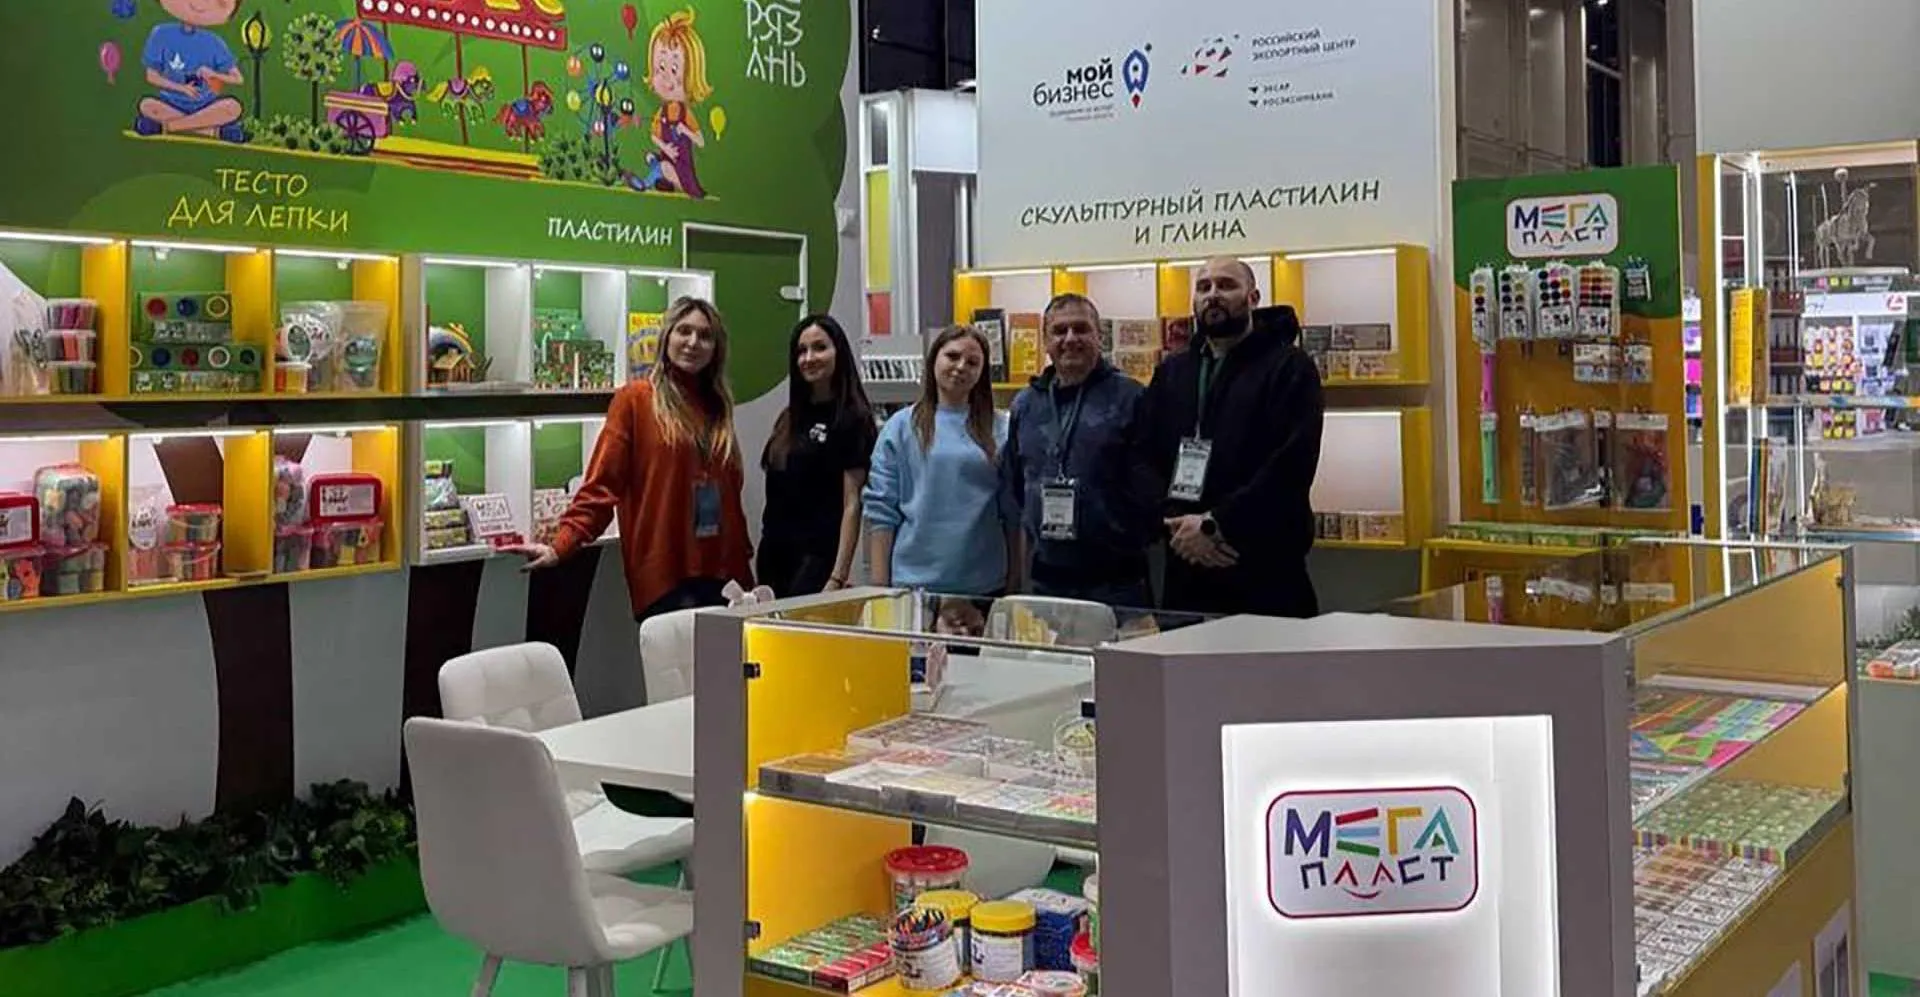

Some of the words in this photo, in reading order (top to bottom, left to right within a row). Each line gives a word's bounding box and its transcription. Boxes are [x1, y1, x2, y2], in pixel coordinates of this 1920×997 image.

[1252, 28, 1320, 47] РОССИЙСКИЙ
[1252, 43, 1320, 61] ЭКСПОРТНЫЙ
[1322, 39, 1357, 51] ЦЕНТР
[1033, 81, 1114, 106] бизнес
[215, 169, 308, 197] ТЕСТО
[167, 196, 235, 228] ДЛЯ
[245, 204, 350, 232] ЛЕПКИ
[1020, 188, 1204, 227] СКУЛЬПТУРНЫЙ
[1213, 180, 1381, 212] ПЛАСТИЛИН
[1514, 203, 1608, 230] МЕГА
[547, 217, 673, 246] ПЛАСТИЛИН
[1134, 225, 1150, 244] И
[1161, 219, 1247, 243] ГЛИНА
[1284, 806, 1460, 858] МЕГА
